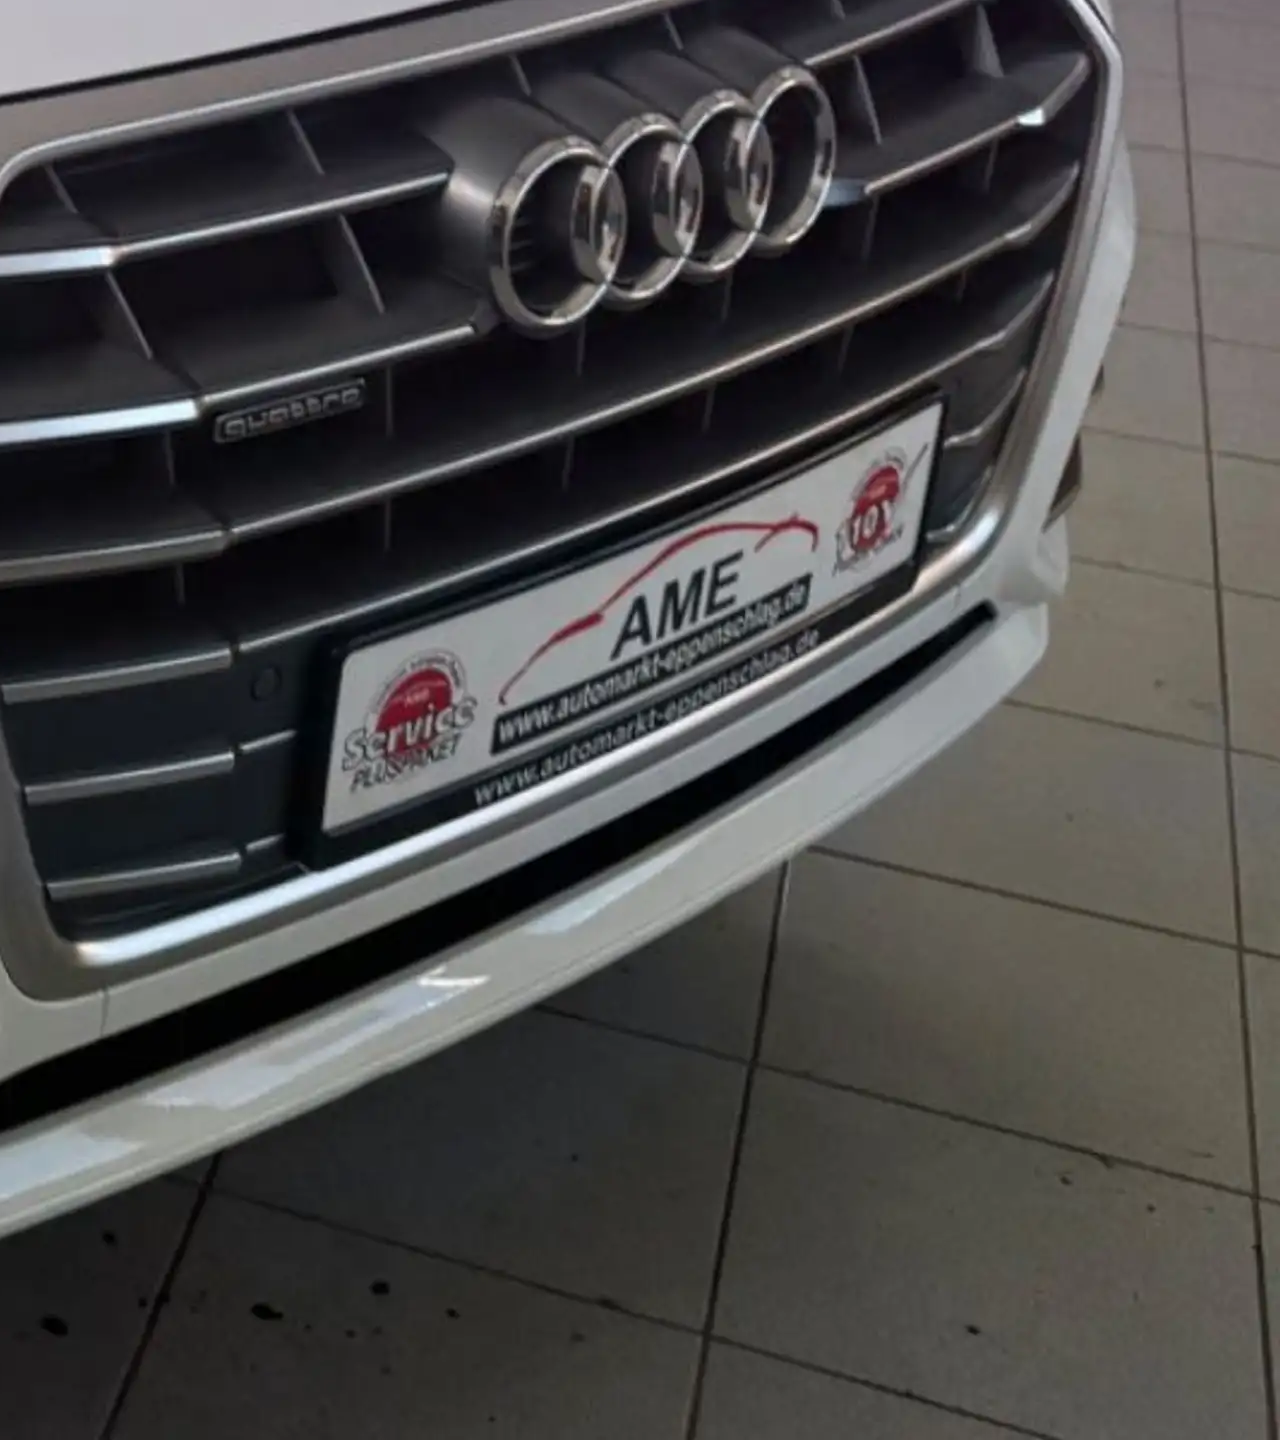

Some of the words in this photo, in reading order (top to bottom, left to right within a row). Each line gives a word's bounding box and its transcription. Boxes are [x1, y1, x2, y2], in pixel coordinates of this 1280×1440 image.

[498, 582, 808, 745] www.automarkt-eppenschlag.de
[609, 550, 744, 662] AME
[474, 628, 820, 807] www.automarkt-eppenschlag.de
